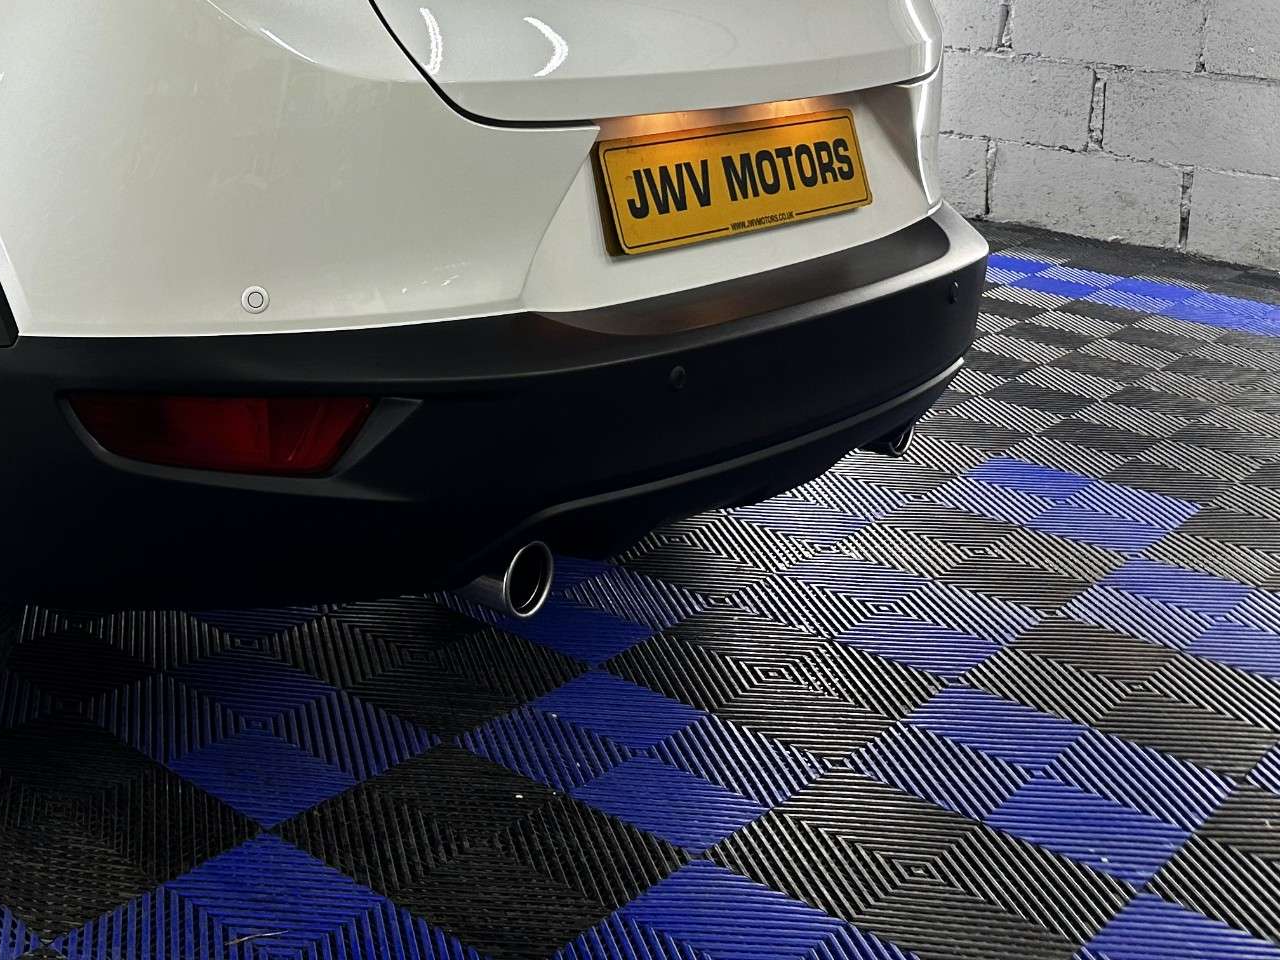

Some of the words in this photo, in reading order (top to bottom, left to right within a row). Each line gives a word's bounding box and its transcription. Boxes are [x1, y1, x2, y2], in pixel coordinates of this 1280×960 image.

[627, 159, 712, 219] JWV
[721, 138, 855, 202] MOTORS
[730, 210, 795, 232] WWW.JWVMOTORS.CO.UK
